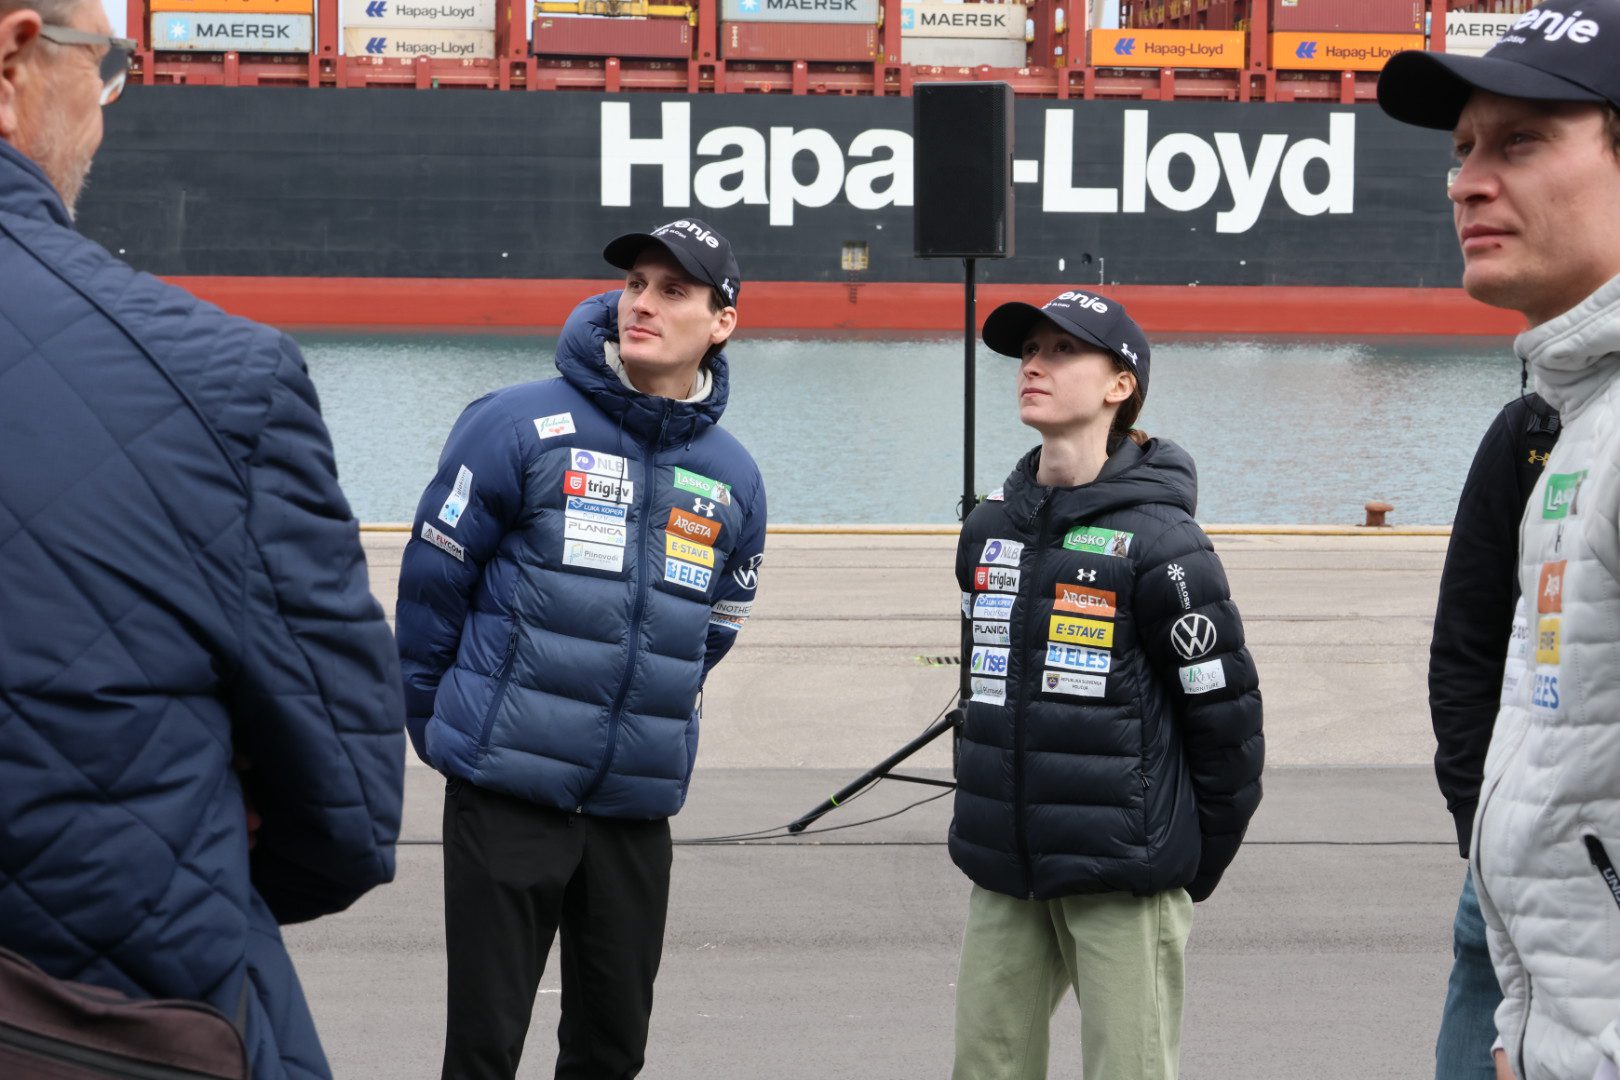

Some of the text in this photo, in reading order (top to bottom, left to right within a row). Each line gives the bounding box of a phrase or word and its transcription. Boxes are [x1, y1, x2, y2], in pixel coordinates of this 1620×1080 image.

[396, 4, 475, 19] Hapag-Lloyd
[920, 13, 1006, 27] MAERSK
[196, 23, 290, 38] MAERSK
[1446, 23, 1507, 37] AERS
[1514, 8, 1601, 44] enje
[396, 41, 475, 55] Hapag-Lloyd
[1144, 42, 1224, 57] Hapag-Lloyd
[601, 101, 1355, 233] Hapa-Lloyd
[674, 219, 720, 249] enje
[1058, 290, 1108, 314] enje
[597, 457, 623, 472] NLB
[588, 479, 630, 498] triglav
[568, 521, 623, 537] PLANICA
[673, 515, 711, 538] ARGETA
[1001, 545, 1019, 561] NLB
[678, 565, 710, 589] ELES
[989, 574, 1017, 591] triglav
[1062, 589, 1109, 609] ARGETA
[974, 624, 1008, 635] PLANICA
[983, 650, 1006, 673] hse
[1064, 648, 1109, 669] ELES
